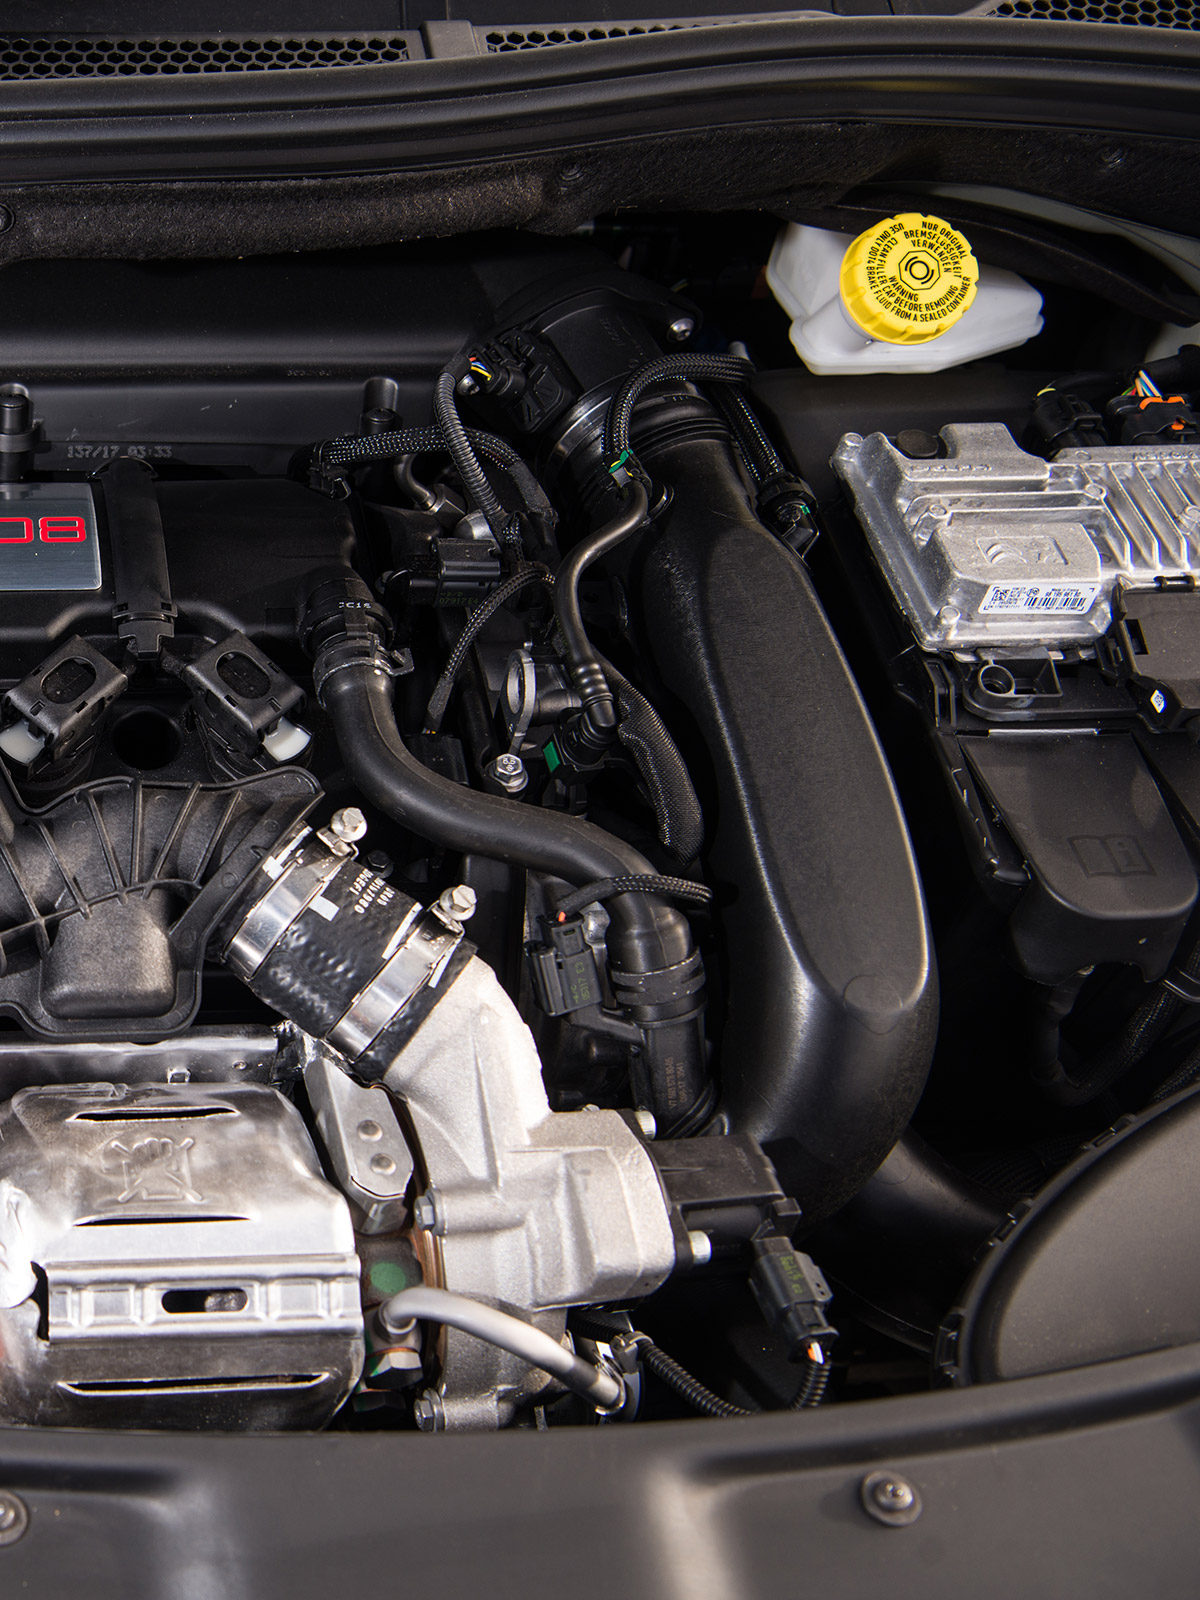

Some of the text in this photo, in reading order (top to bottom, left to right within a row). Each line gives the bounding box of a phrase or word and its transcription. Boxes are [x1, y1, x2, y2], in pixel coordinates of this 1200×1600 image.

[875, 230, 891, 247] ONLY
[888, 222, 905, 235] USE
[921, 221, 968, 260] NUR ORIGINAL
[903, 229, 962, 279] BREMSFLÜSSIGKEIT
[910, 239, 952, 273] VERWENDEN
[866, 266, 879, 291] BRAKE
[876, 237, 959, 312] CLEAN FILLER CAP BEFORE REMOVING
[873, 288, 892, 310] FLUID
[888, 275, 919, 303] WARNING
[946, 276, 971, 313] CONTAINER
[890, 305, 912, 321] FROM
[912, 313, 918, 322] A
[920, 309, 948, 322] SEALED
[67, 445, 120, 458] 137/17
